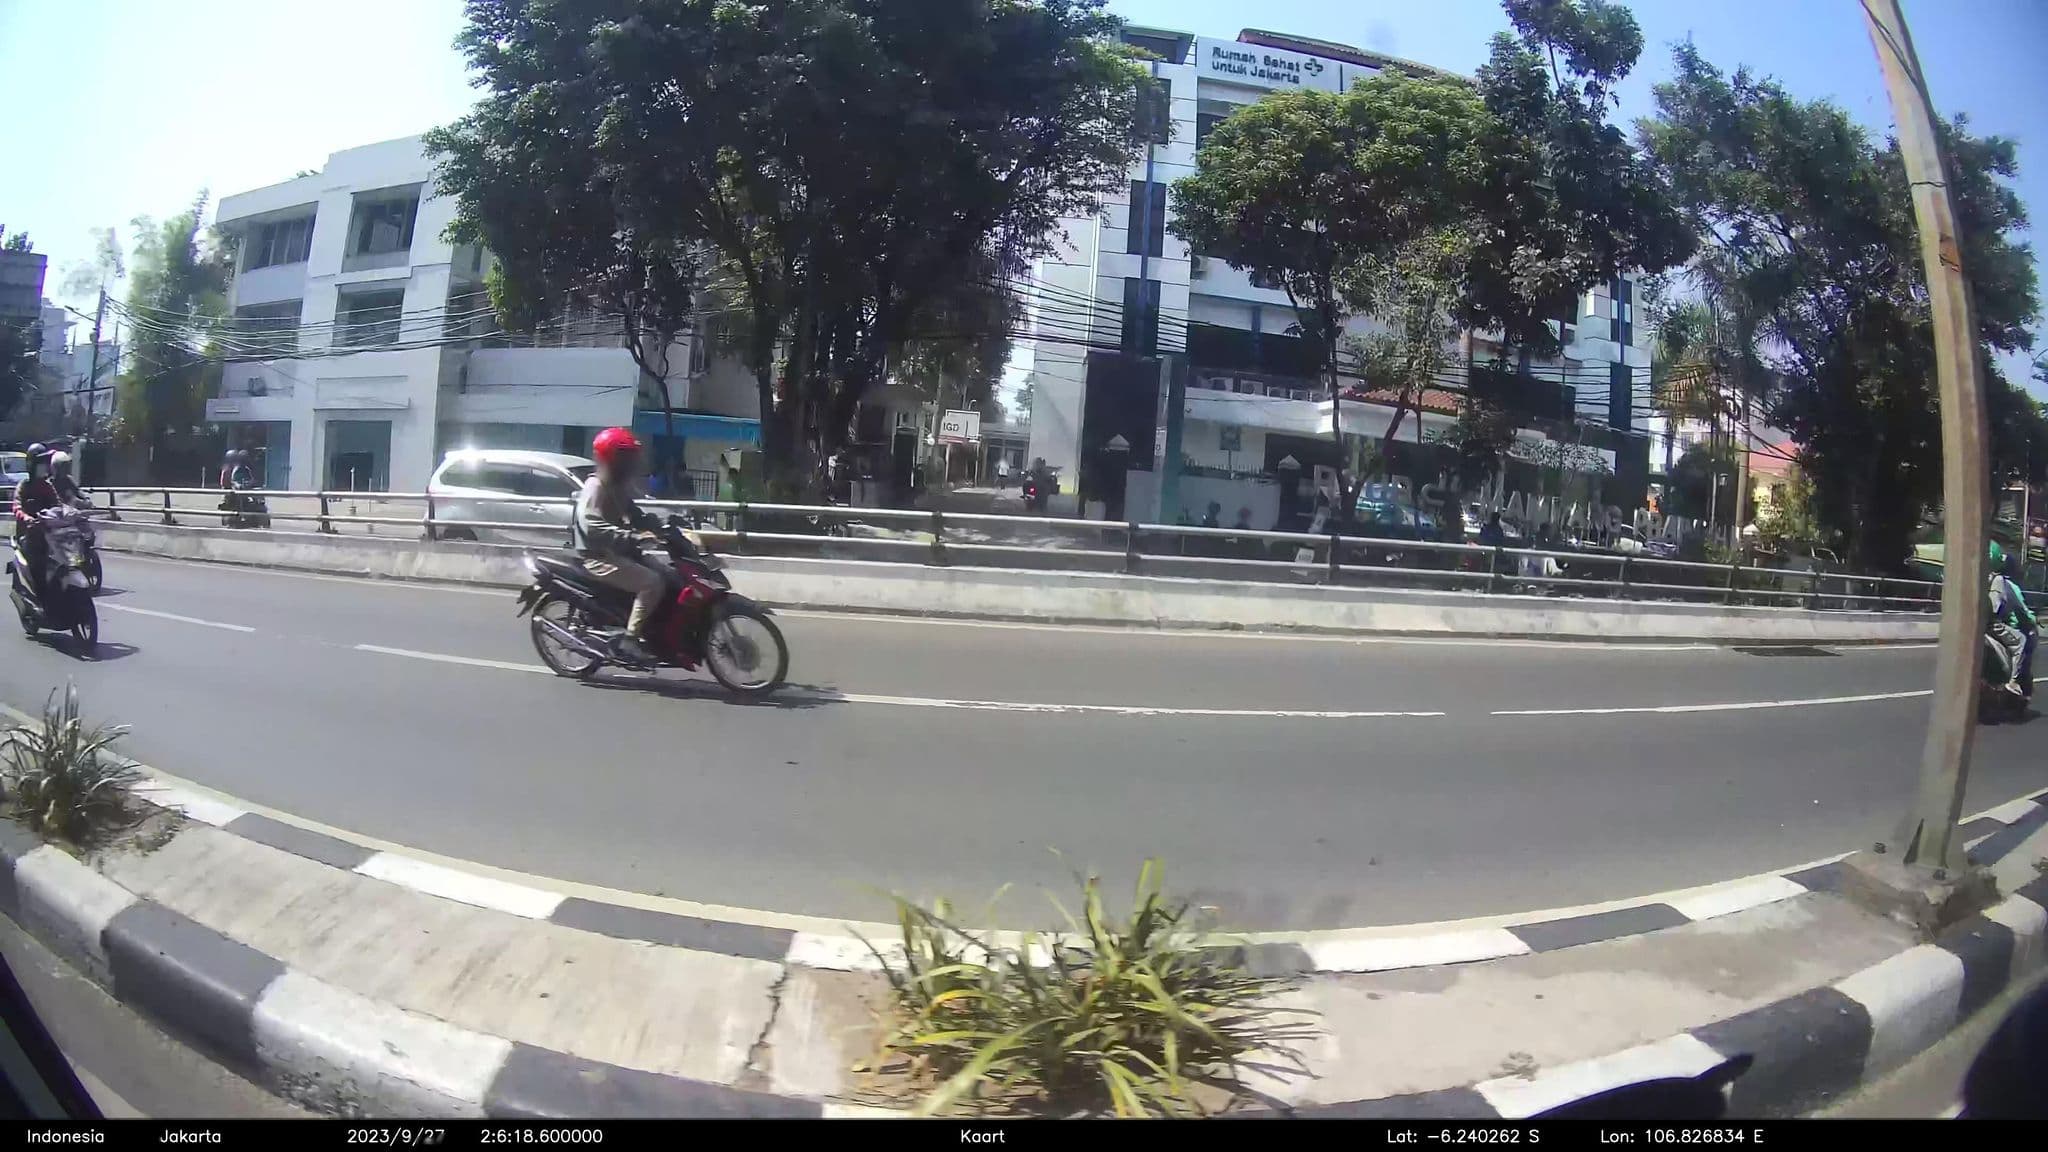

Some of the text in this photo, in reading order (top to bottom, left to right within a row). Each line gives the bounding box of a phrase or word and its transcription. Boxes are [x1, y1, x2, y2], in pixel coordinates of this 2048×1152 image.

[1212, 46, 1256, 64] Rumah
[1250, 65, 1300, 84] Jakarta
[943, 421, 960, 432] IGD
